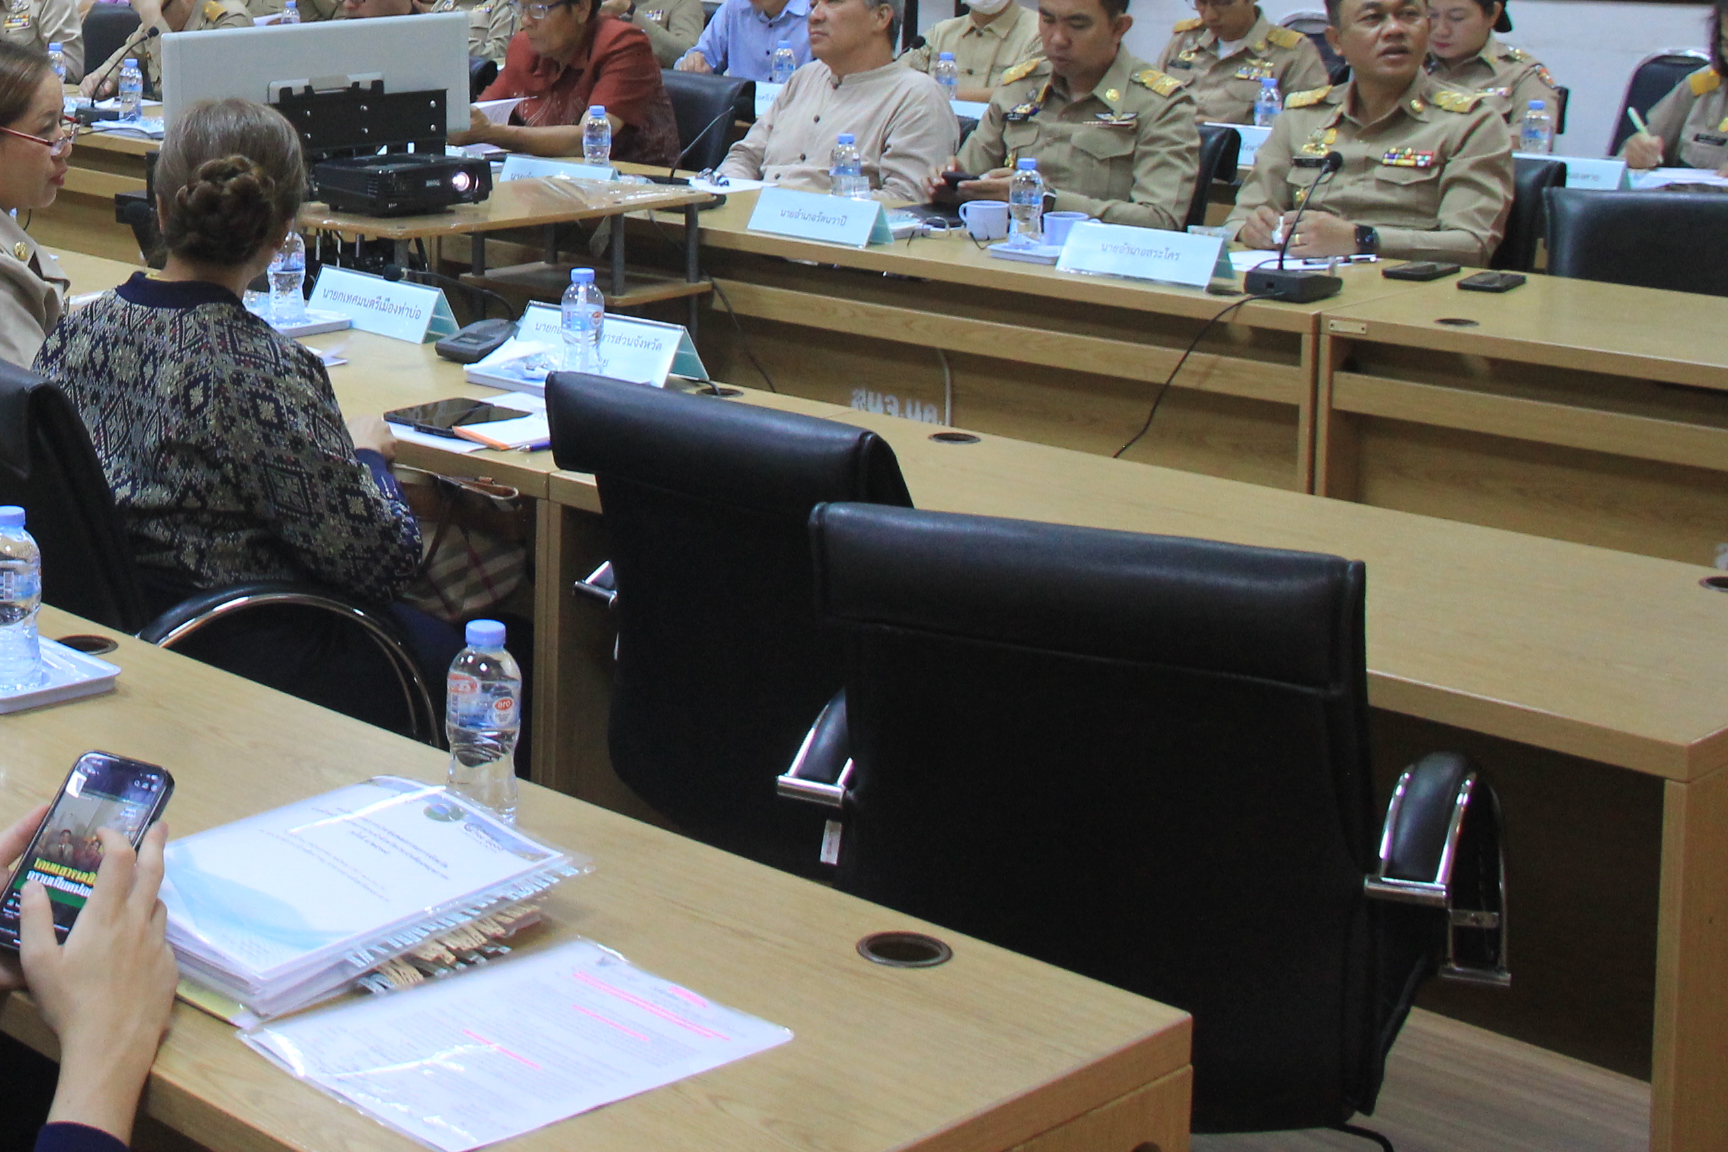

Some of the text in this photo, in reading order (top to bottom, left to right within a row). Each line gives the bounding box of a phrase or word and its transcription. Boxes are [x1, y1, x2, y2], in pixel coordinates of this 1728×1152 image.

[779, 208, 848, 227] นายอำเภอรัตนวาปี
[322, 288, 422, 320] นายกเทศมนตรีเมืองท่าบ่อ
[497, 700, 511, 709] aro
